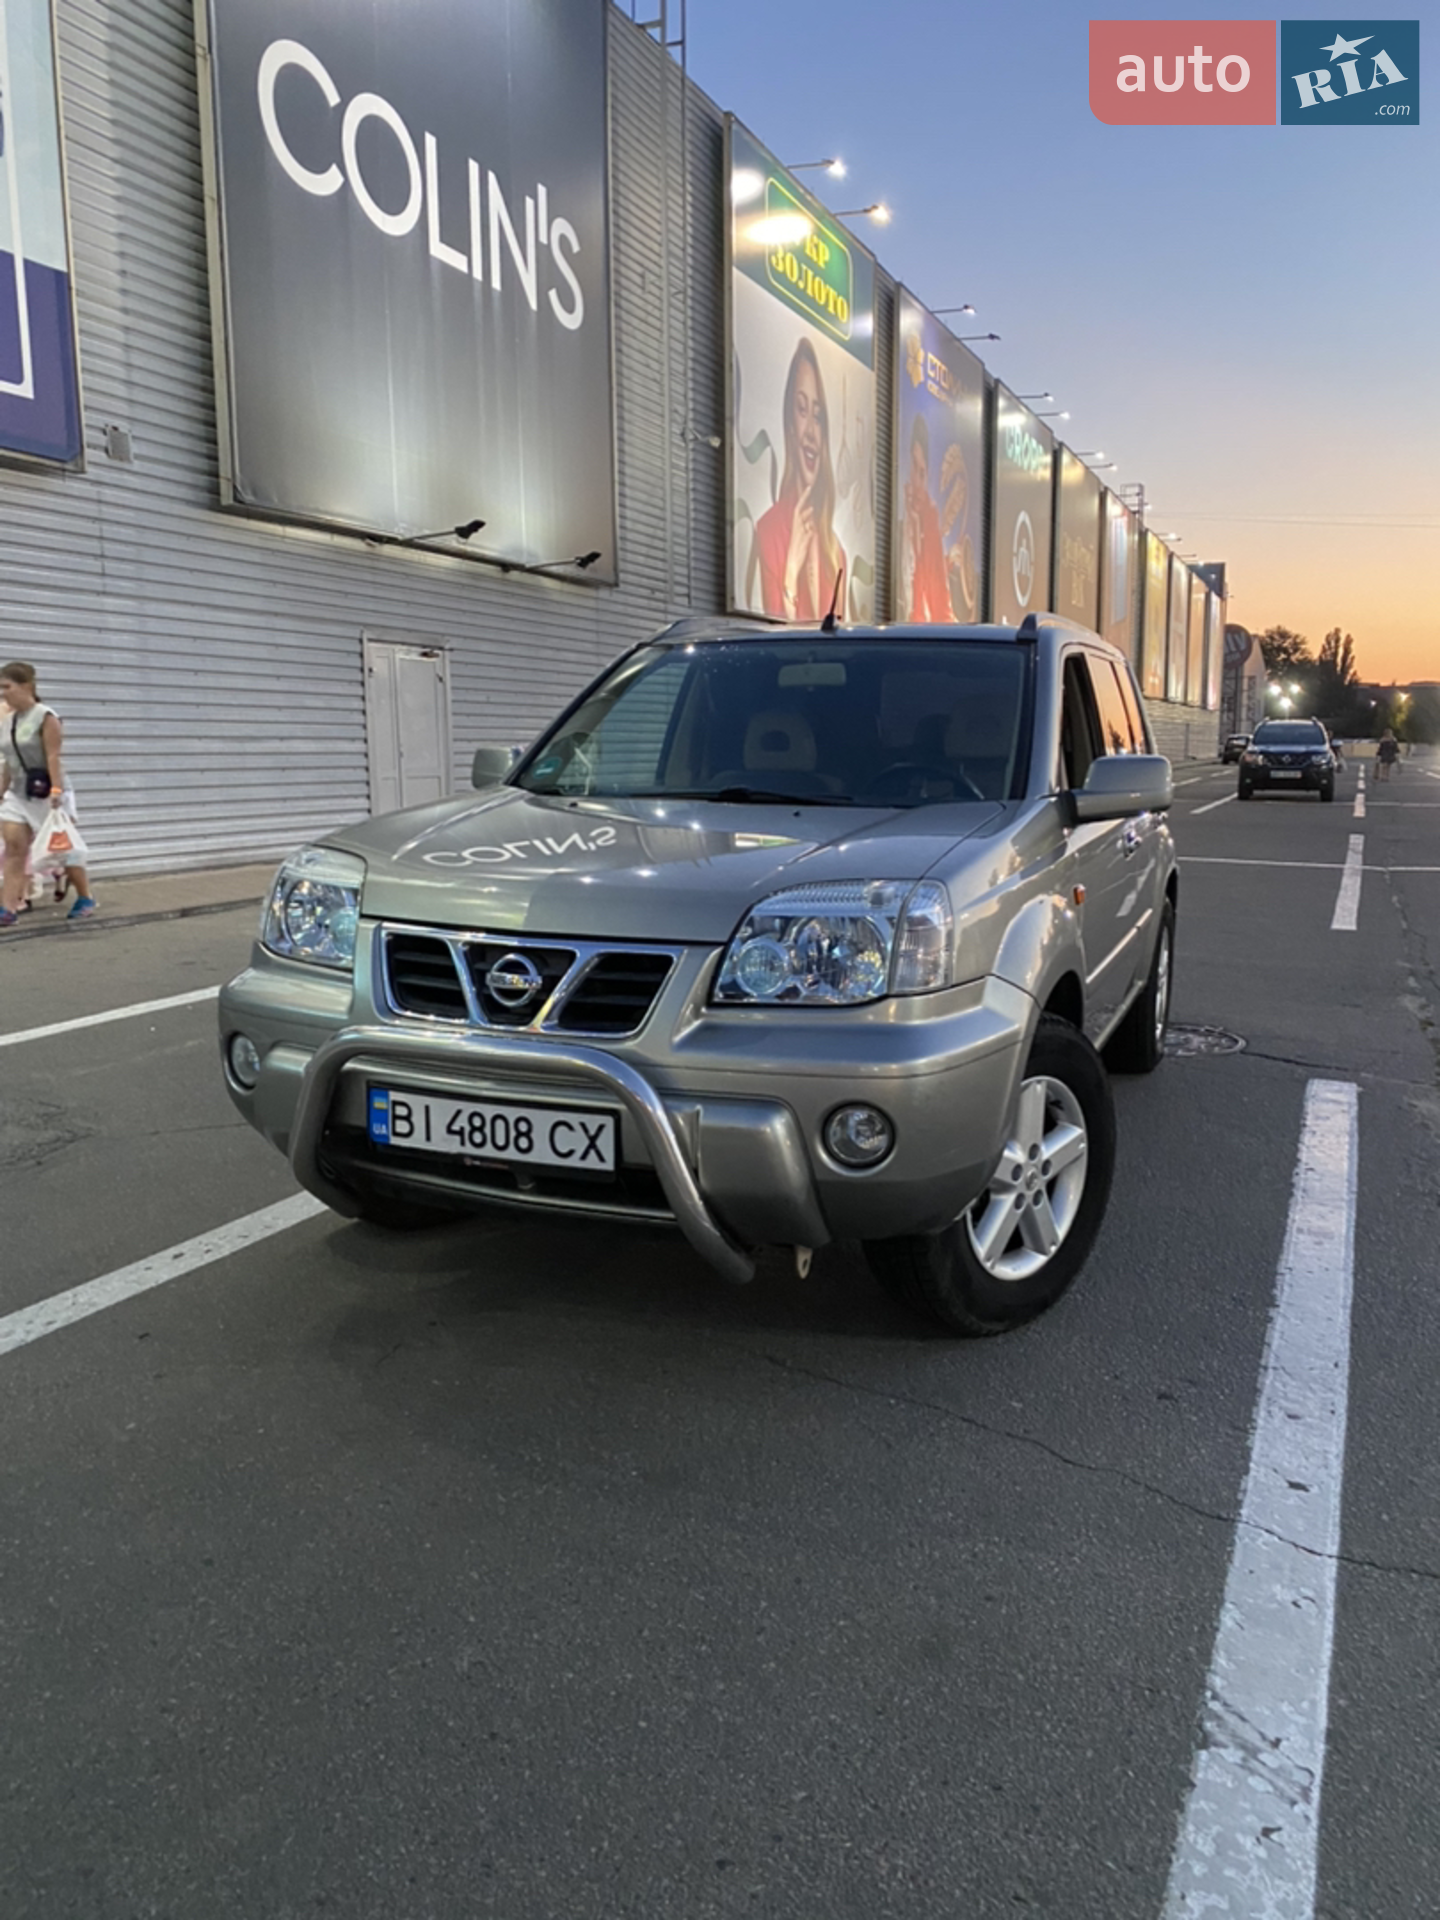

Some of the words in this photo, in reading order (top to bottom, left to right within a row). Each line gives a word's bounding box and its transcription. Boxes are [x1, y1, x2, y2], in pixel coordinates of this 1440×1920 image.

[257, 39, 584, 330] COLIN'S
[771, 243, 848, 324] ЗОЛОТО
[373, 1123, 388, 1136] UA
[391, 1100, 432, 1143] BI
[446, 1109, 534, 1155] 4808
[549, 1120, 607, 1164] CX
